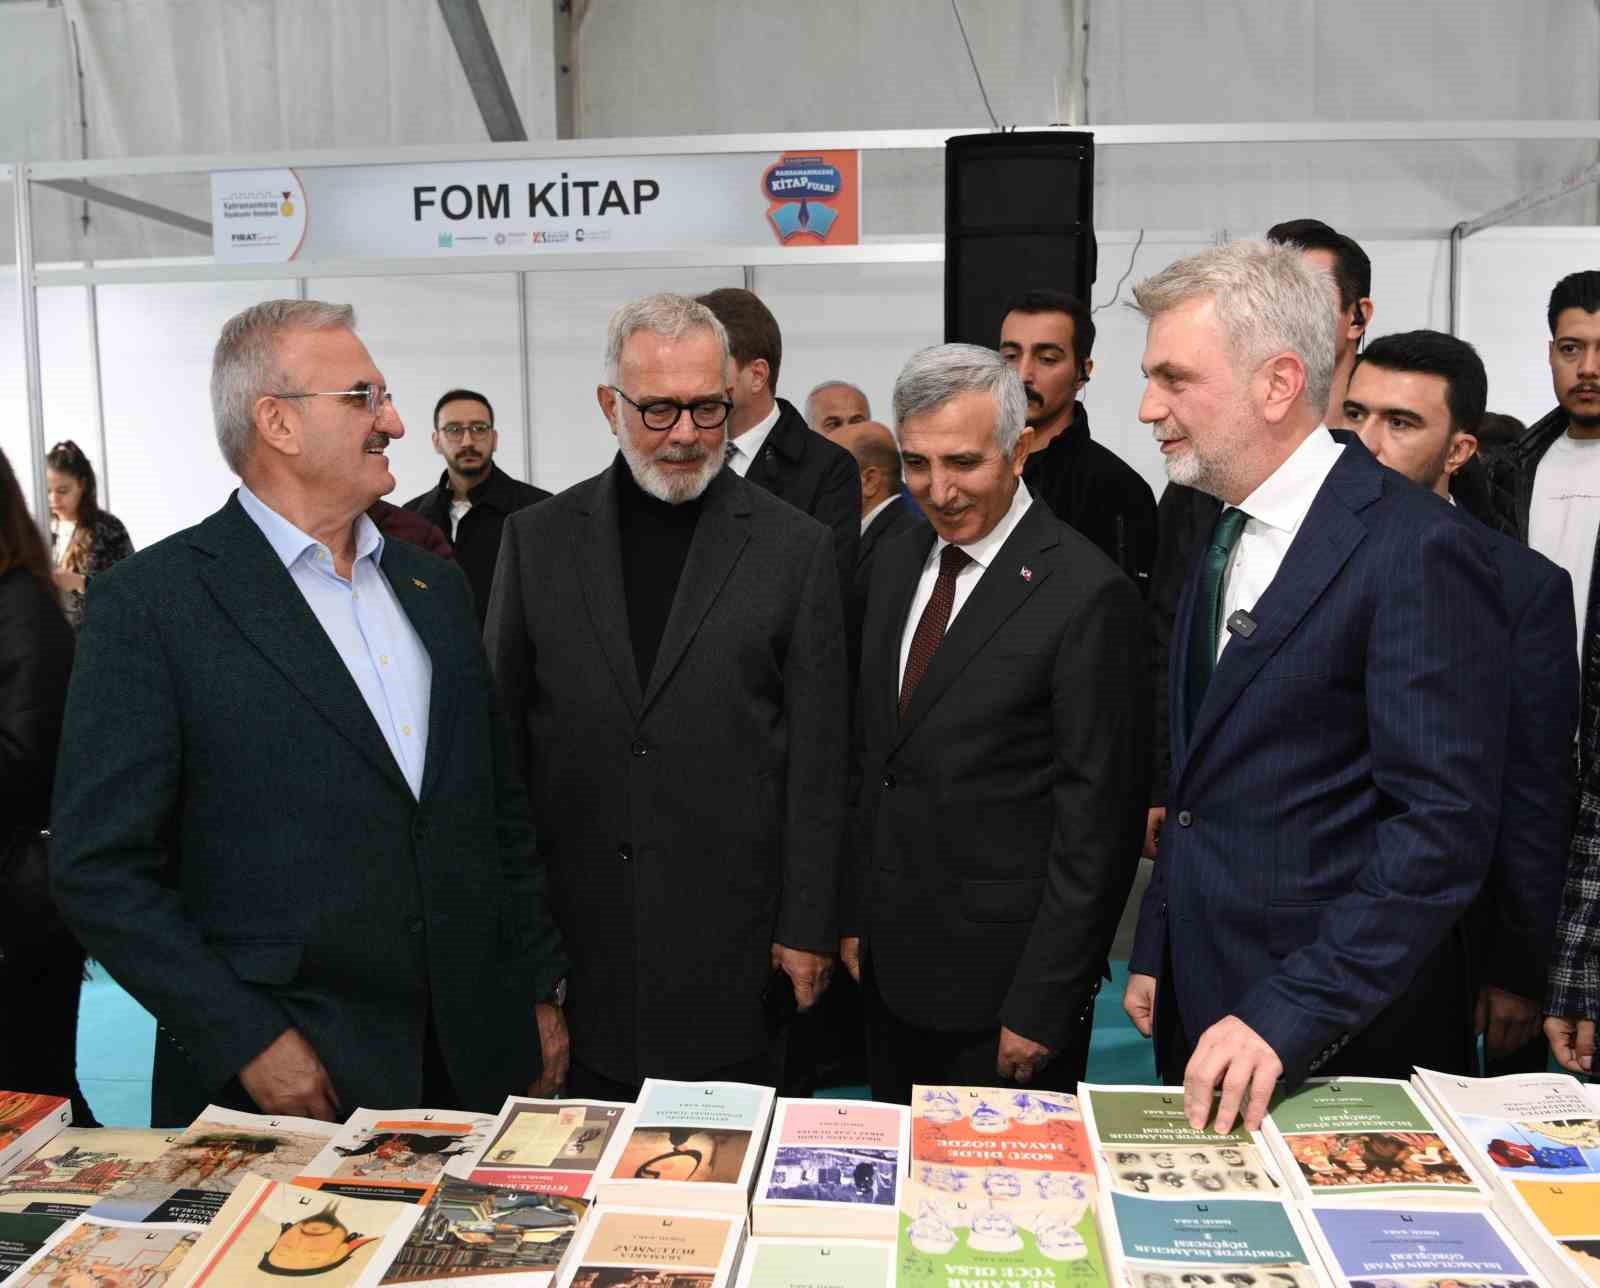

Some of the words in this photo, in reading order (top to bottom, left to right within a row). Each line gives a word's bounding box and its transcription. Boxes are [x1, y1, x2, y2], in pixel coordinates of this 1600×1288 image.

[771, 177, 809, 191] KİTAP
[807, 182, 835, 193] FUARI
[413, 184, 510, 221] FOM
[528, 172, 660, 218] KİTAP
[1001, 1141, 1065, 1151] HAYALİ
[947, 1150, 1004, 1160] DİLDE
[1008, 1151, 1055, 1161] SÖZÜ
[1173, 1239, 1248, 1249] DÜŞÜNCESİ
[945, 1264, 997, 1277] OLSA
[1001, 1266, 1057, 1278] YÜCE
